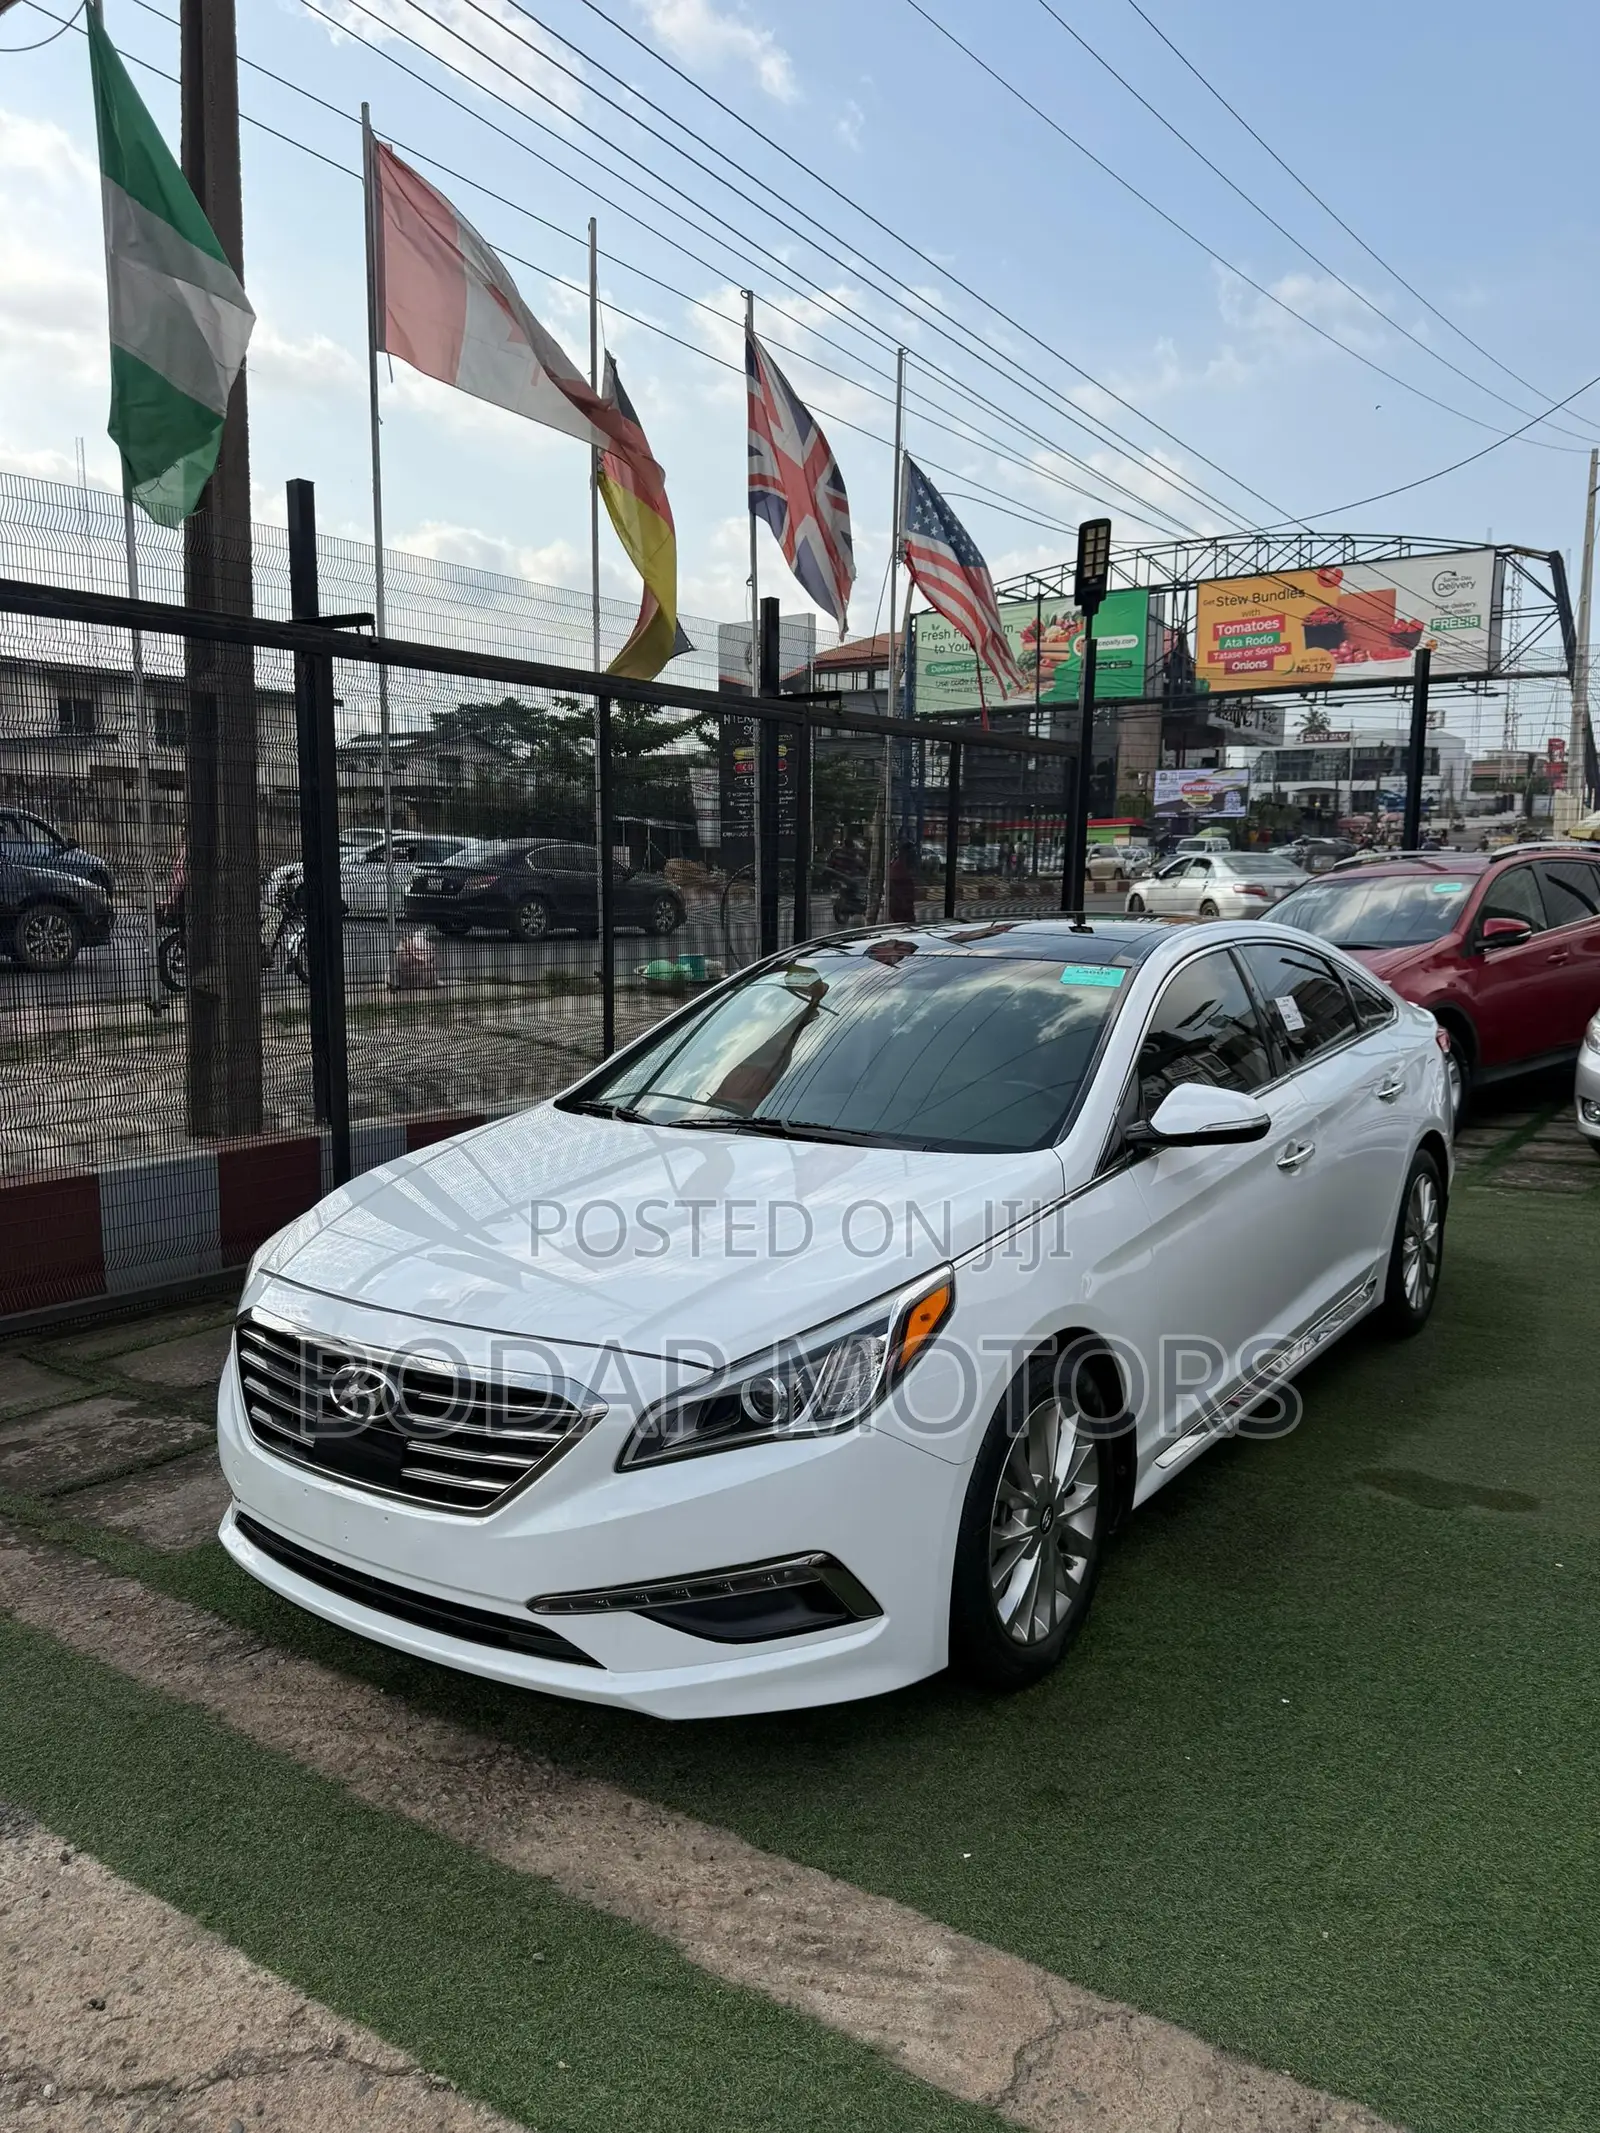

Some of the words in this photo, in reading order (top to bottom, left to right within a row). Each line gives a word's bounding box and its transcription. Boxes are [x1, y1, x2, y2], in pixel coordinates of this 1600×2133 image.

[1437, 580, 1476, 591] Delivery
[1216, 596, 1248, 607] Stew
[1252, 588, 1305, 603] Bundles
[1241, 608, 1261, 618] with
[1216, 619, 1280, 635] Tomatoes
[921, 629, 951, 641] Fresh
[1224, 638, 1243, 649] Ata
[1245, 635, 1274, 646] Rodo
[934, 644, 946, 654] to
[1213, 650, 1243, 660] Tatase
[1255, 645, 1287, 656] Sombo
[1231, 659, 1269, 671] Onions
